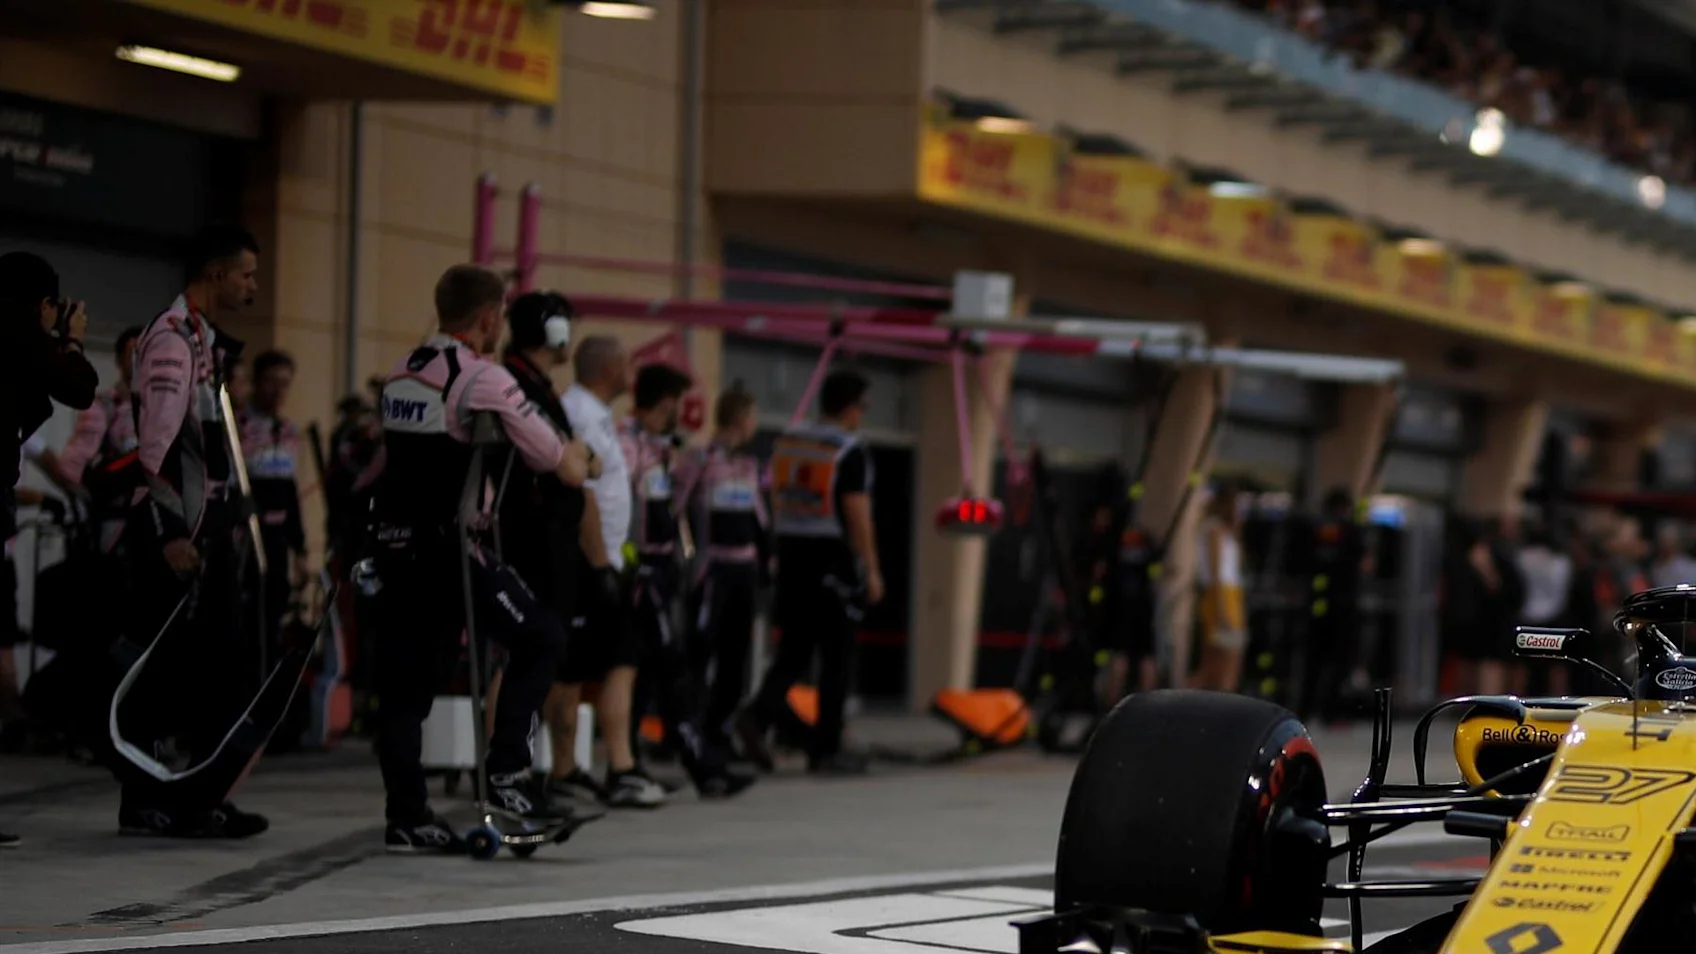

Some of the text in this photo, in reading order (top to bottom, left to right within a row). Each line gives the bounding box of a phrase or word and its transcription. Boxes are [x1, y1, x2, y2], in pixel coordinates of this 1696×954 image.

[391, 402, 428, 422] BWT
[1526, 634, 1561, 648] Castrol
[1482, 727, 1510, 742] Bell
[1517, 897, 1595, 912] Castrol
